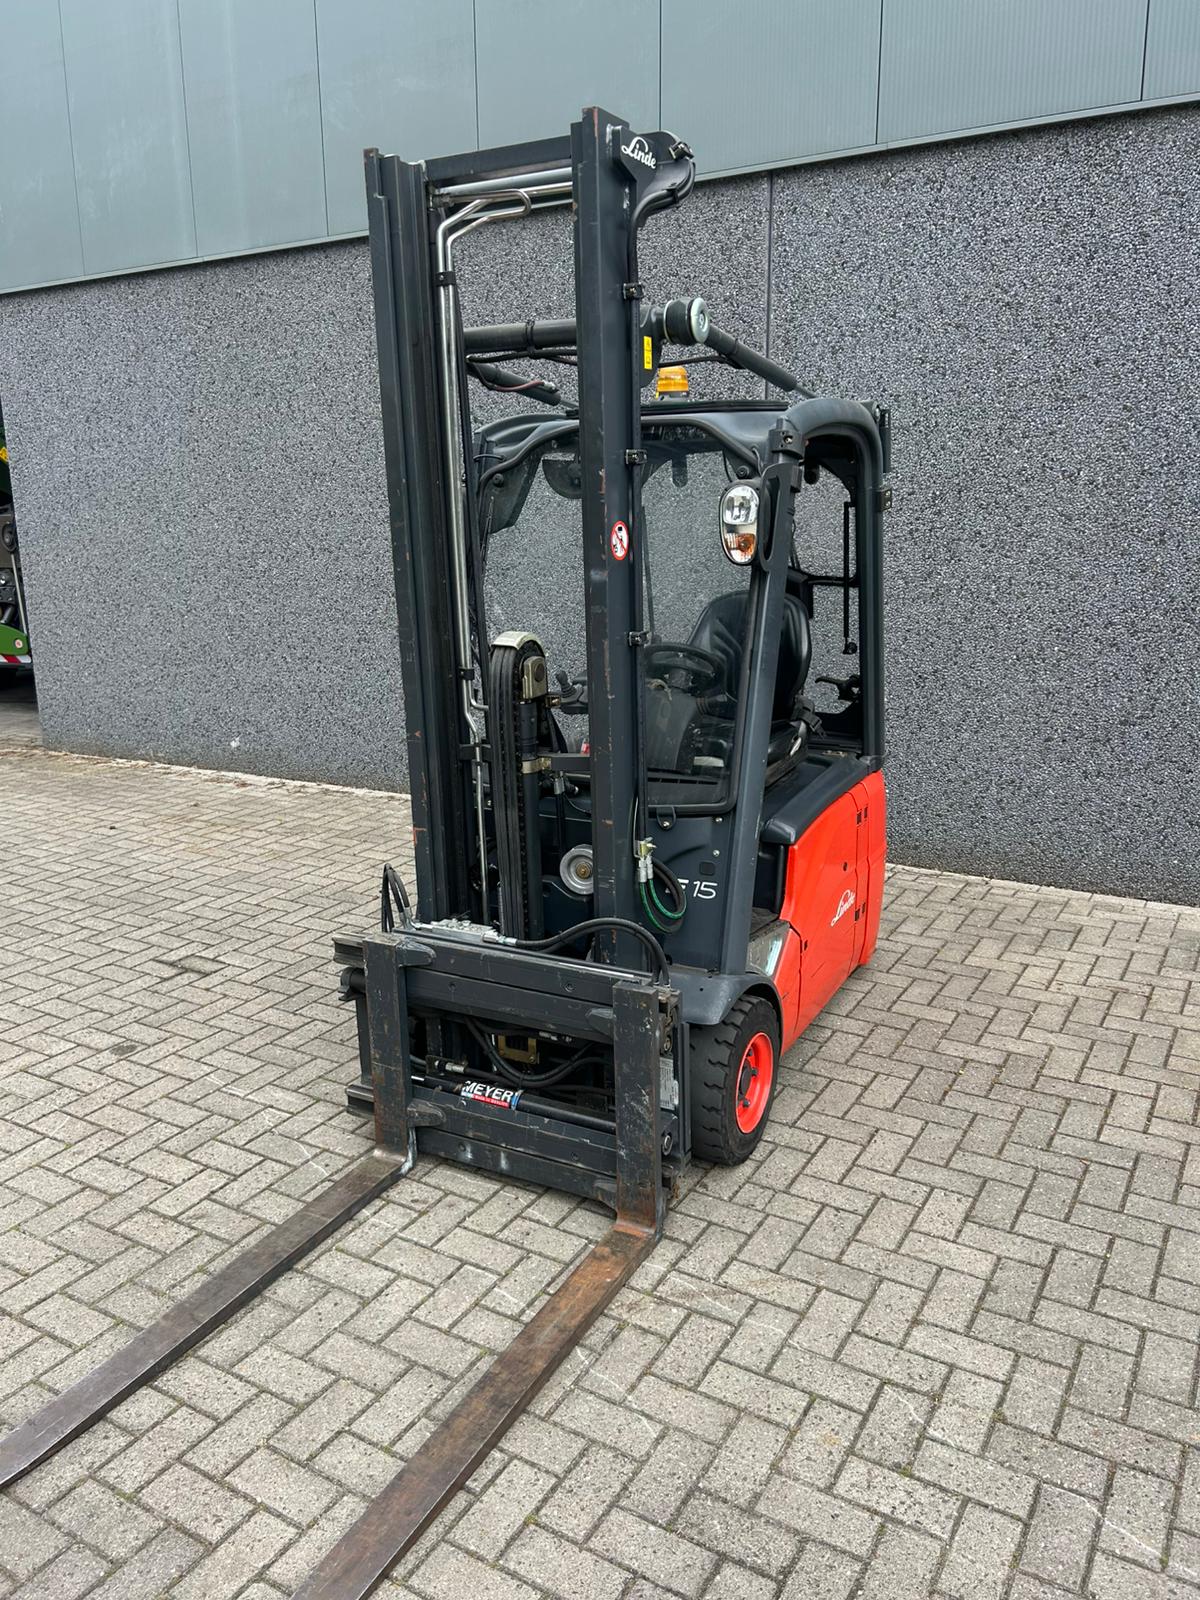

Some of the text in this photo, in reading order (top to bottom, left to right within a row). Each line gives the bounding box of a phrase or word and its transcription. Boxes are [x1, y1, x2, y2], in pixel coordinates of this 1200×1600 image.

[621, 136, 656, 169] Linde
[830, 889, 856, 927] Linde
[461, 1080, 514, 1103] MEYER
